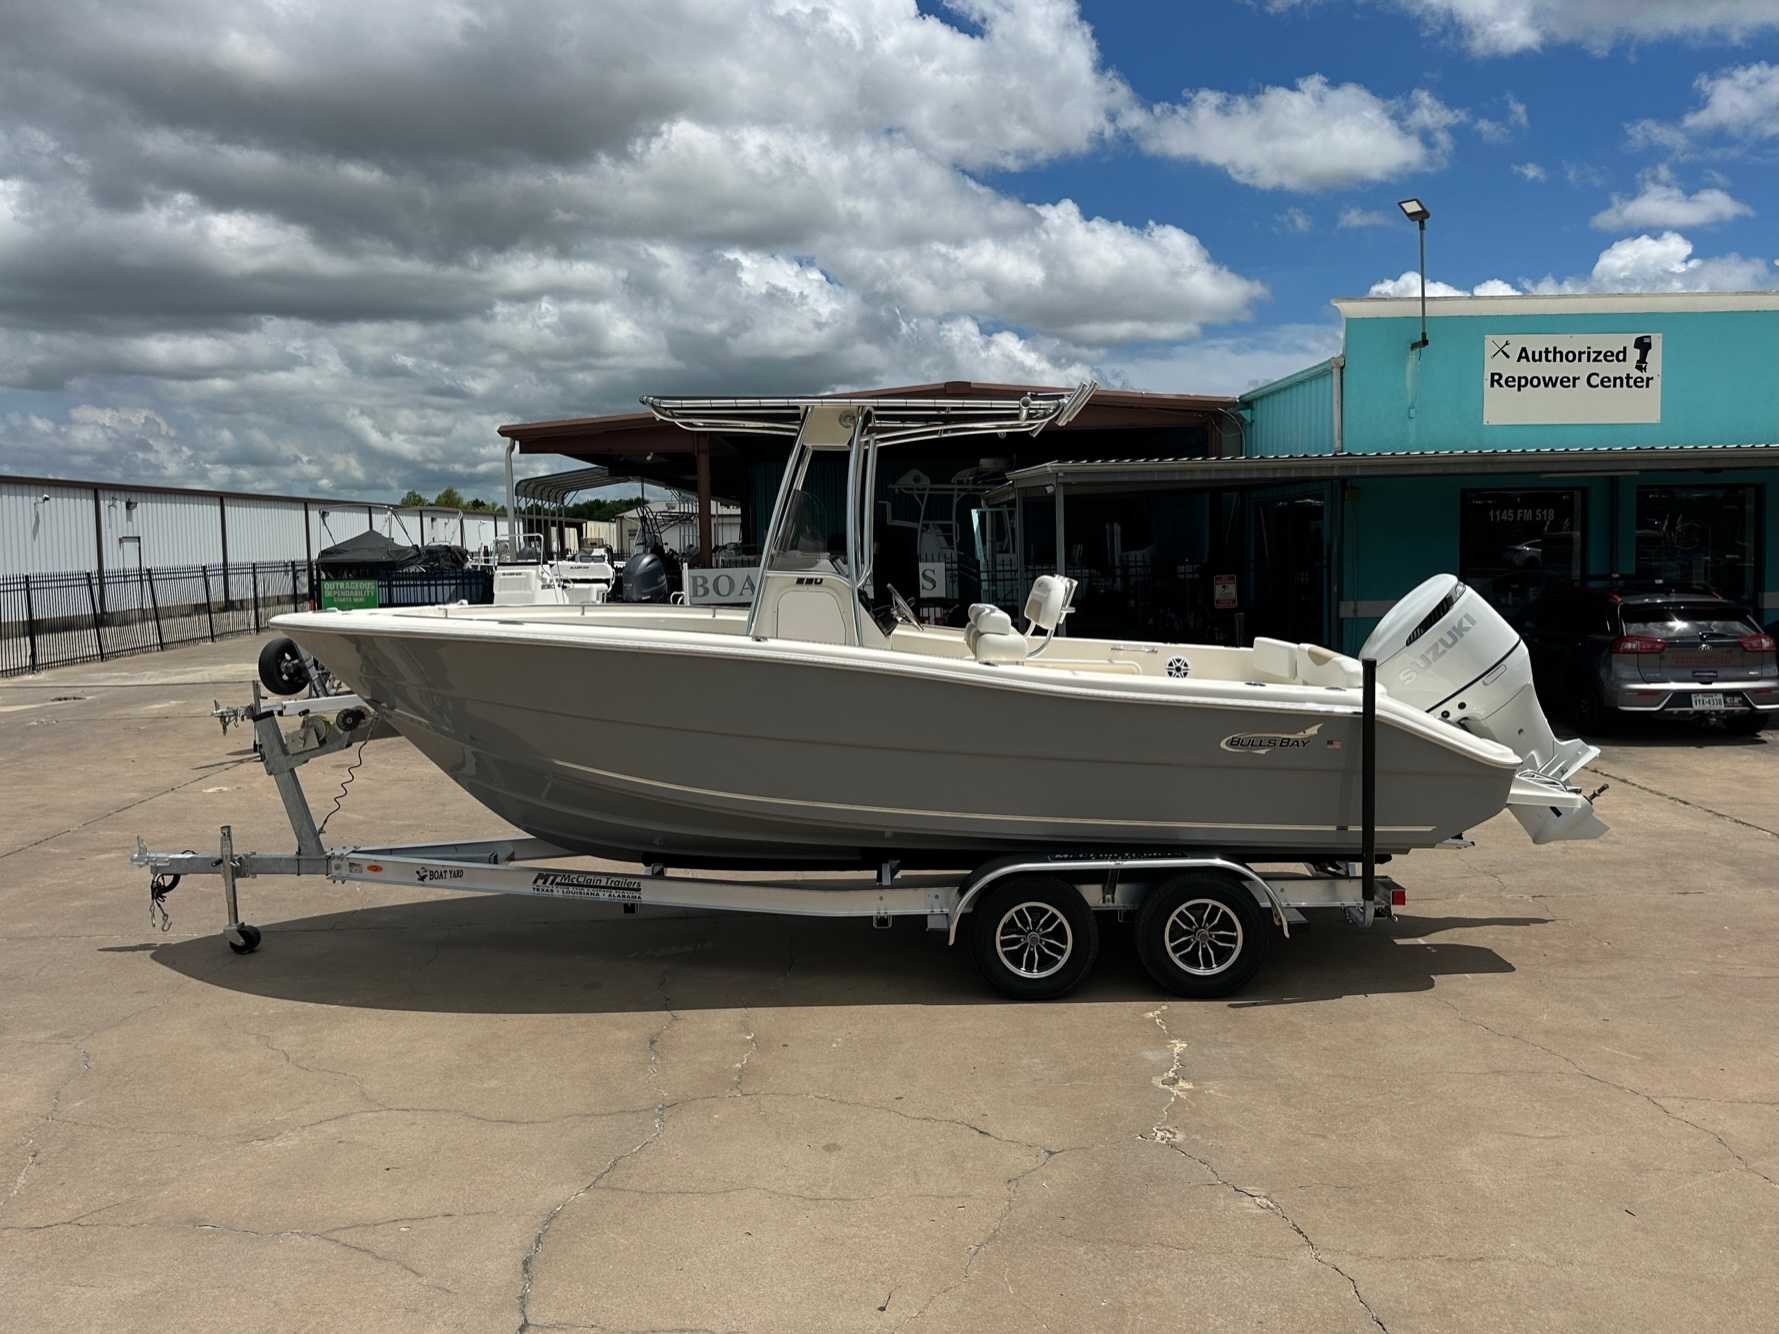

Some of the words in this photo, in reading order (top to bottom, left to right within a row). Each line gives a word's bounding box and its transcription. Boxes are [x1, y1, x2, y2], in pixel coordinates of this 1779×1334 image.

[1516, 346, 1627, 363] Authorized
[1489, 372, 1581, 392] Repower
[1585, 372, 1654, 389] Center
[1489, 508, 1514, 521] 1145
[1516, 508, 1532, 521] FM
[1536, 508, 1554, 521] 518
[691, 573, 757, 598] BOA
[1399, 613, 1477, 686] SUZUKI
[1229, 736, 1277, 748] BULLS
[1279, 737, 1311, 748] BAY
[429, 870, 447, 880] BOAT
[448, 869, 464, 879] YARD
[605, 877, 641, 888] Trailers
